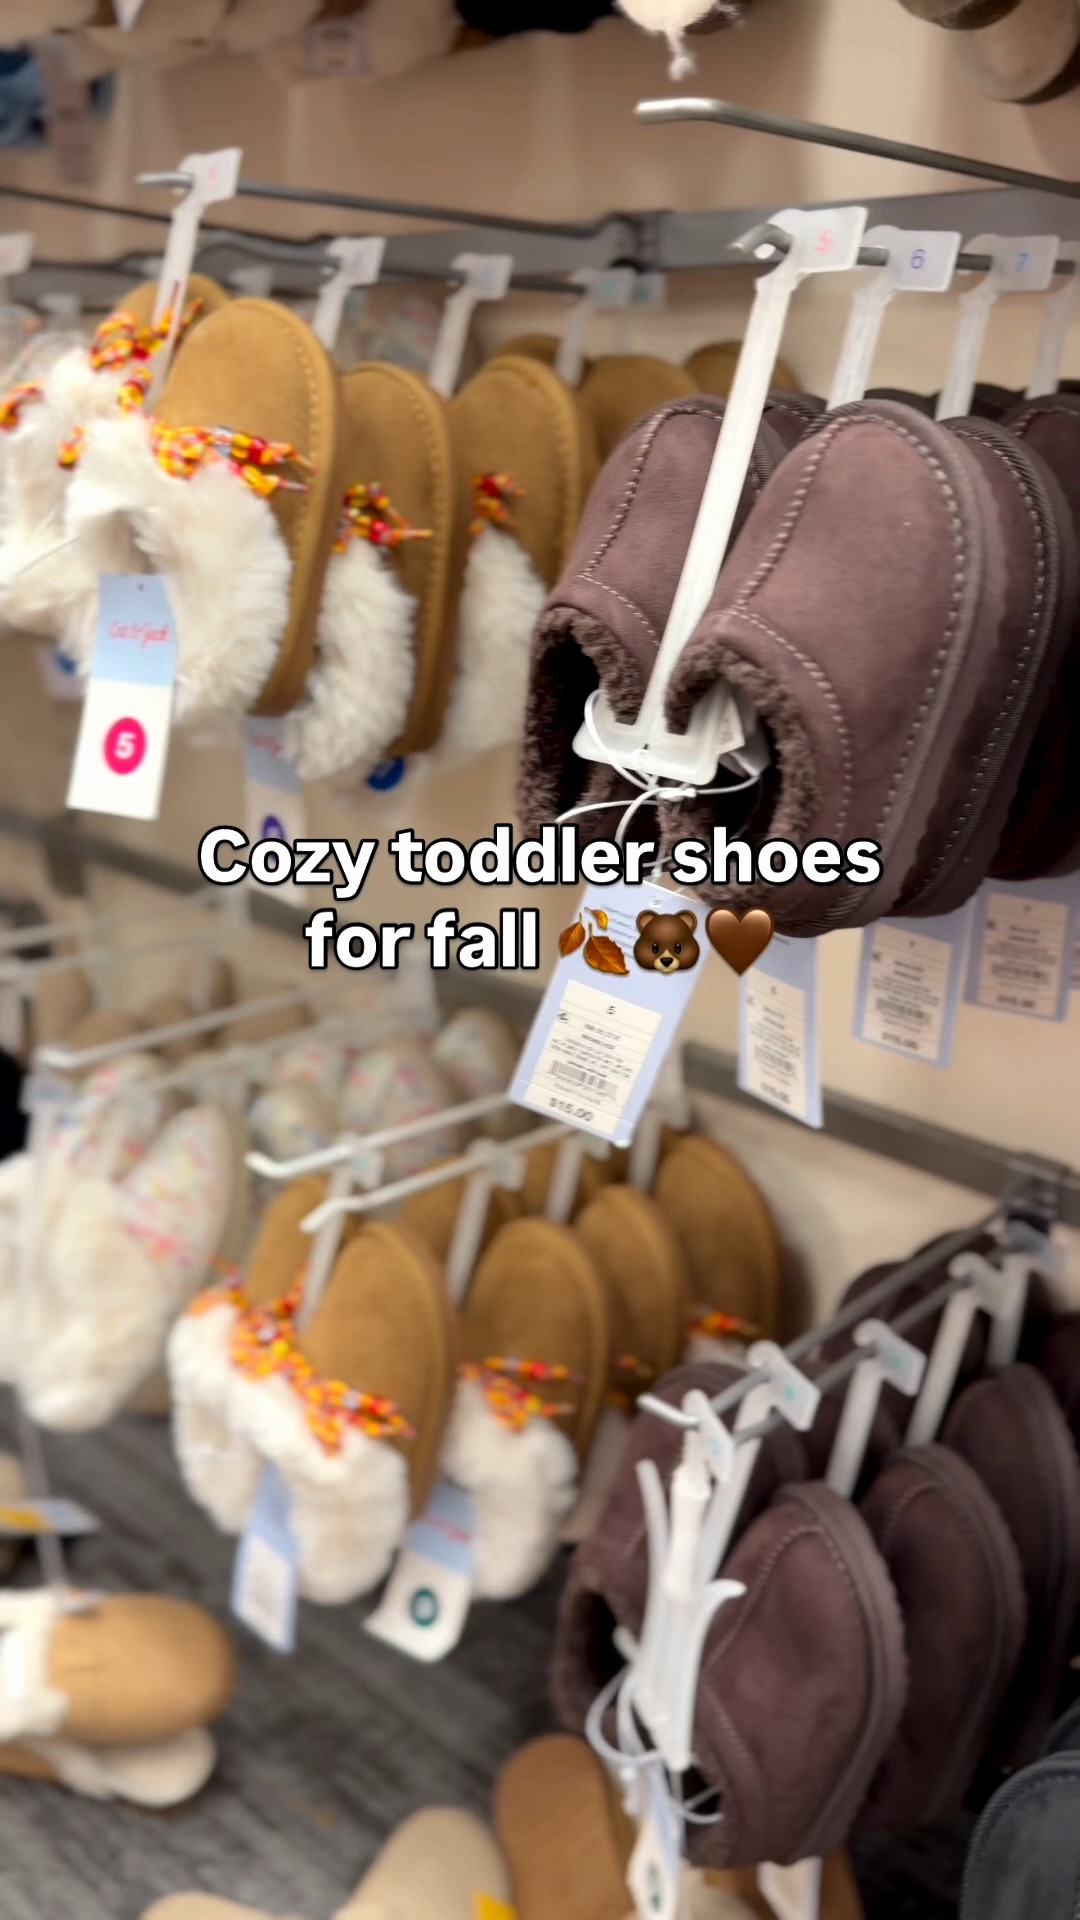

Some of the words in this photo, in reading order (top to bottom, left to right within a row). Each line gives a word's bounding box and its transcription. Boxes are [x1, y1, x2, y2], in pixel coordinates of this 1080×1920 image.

[910, 249, 926, 269] 6
[1015, 253, 1031, 273] 7
[113, 731, 137, 760] 5
[606, 1005, 617, 1015] 5
[548, 1096, 595, 1122] $15.00
